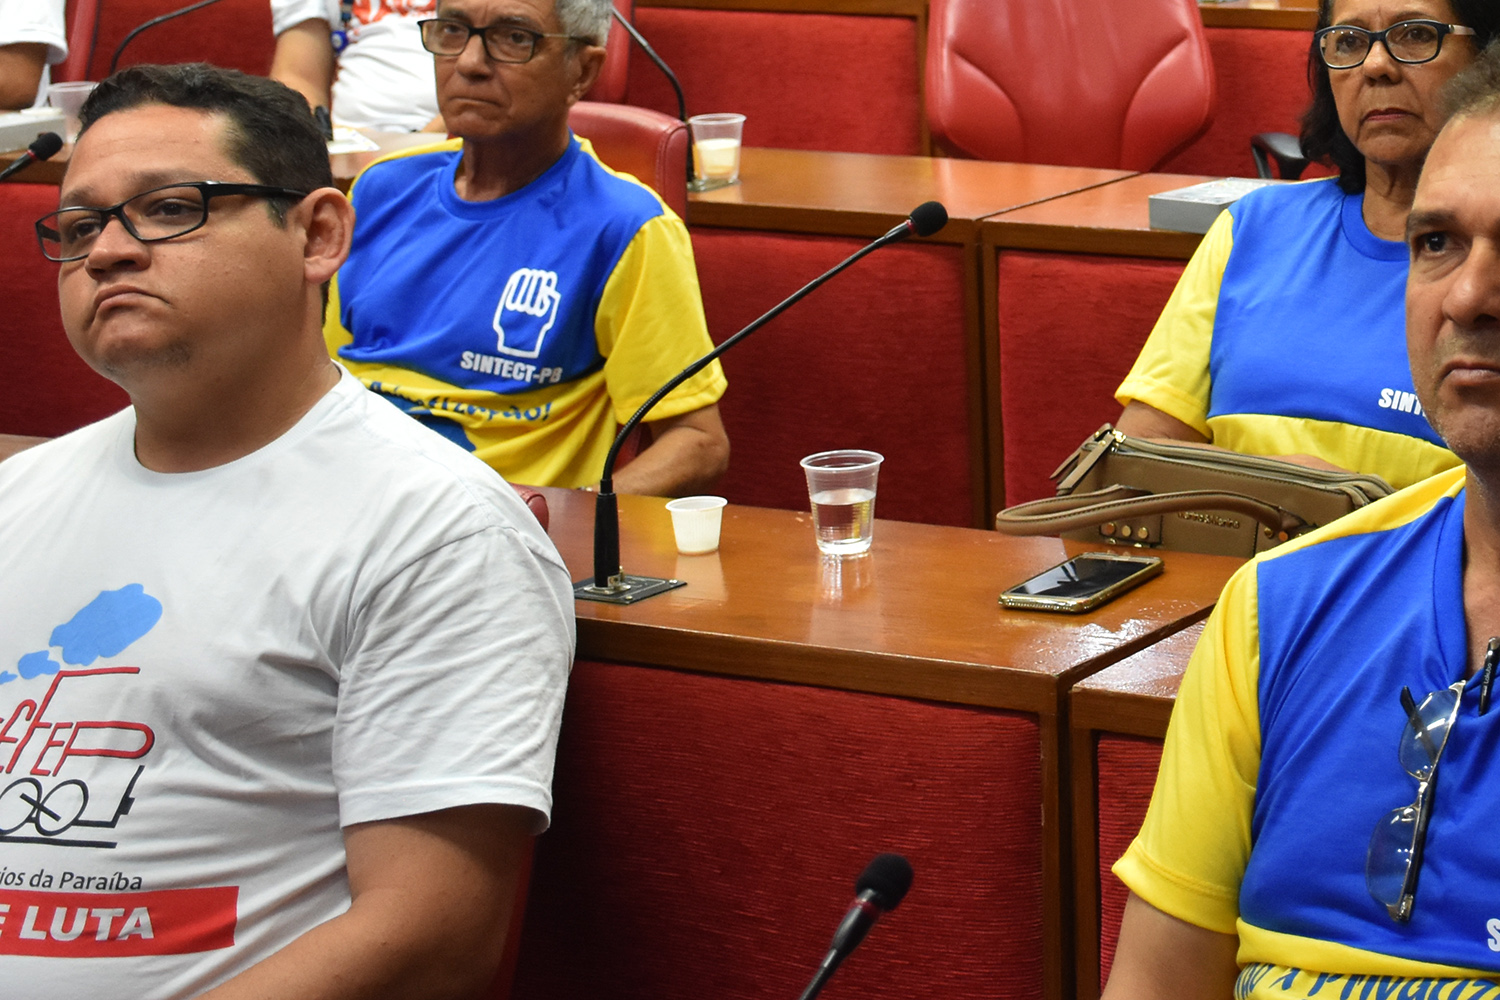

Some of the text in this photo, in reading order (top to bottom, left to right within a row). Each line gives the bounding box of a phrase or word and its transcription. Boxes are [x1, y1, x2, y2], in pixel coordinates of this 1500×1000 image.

[460, 350, 564, 384] SINTECT-PB
[1378, 388, 1427, 418] SINT
[29, 868, 54, 889] da
[59, 870, 143, 891] Paraíba
[19, 904, 155, 942] LUTA
